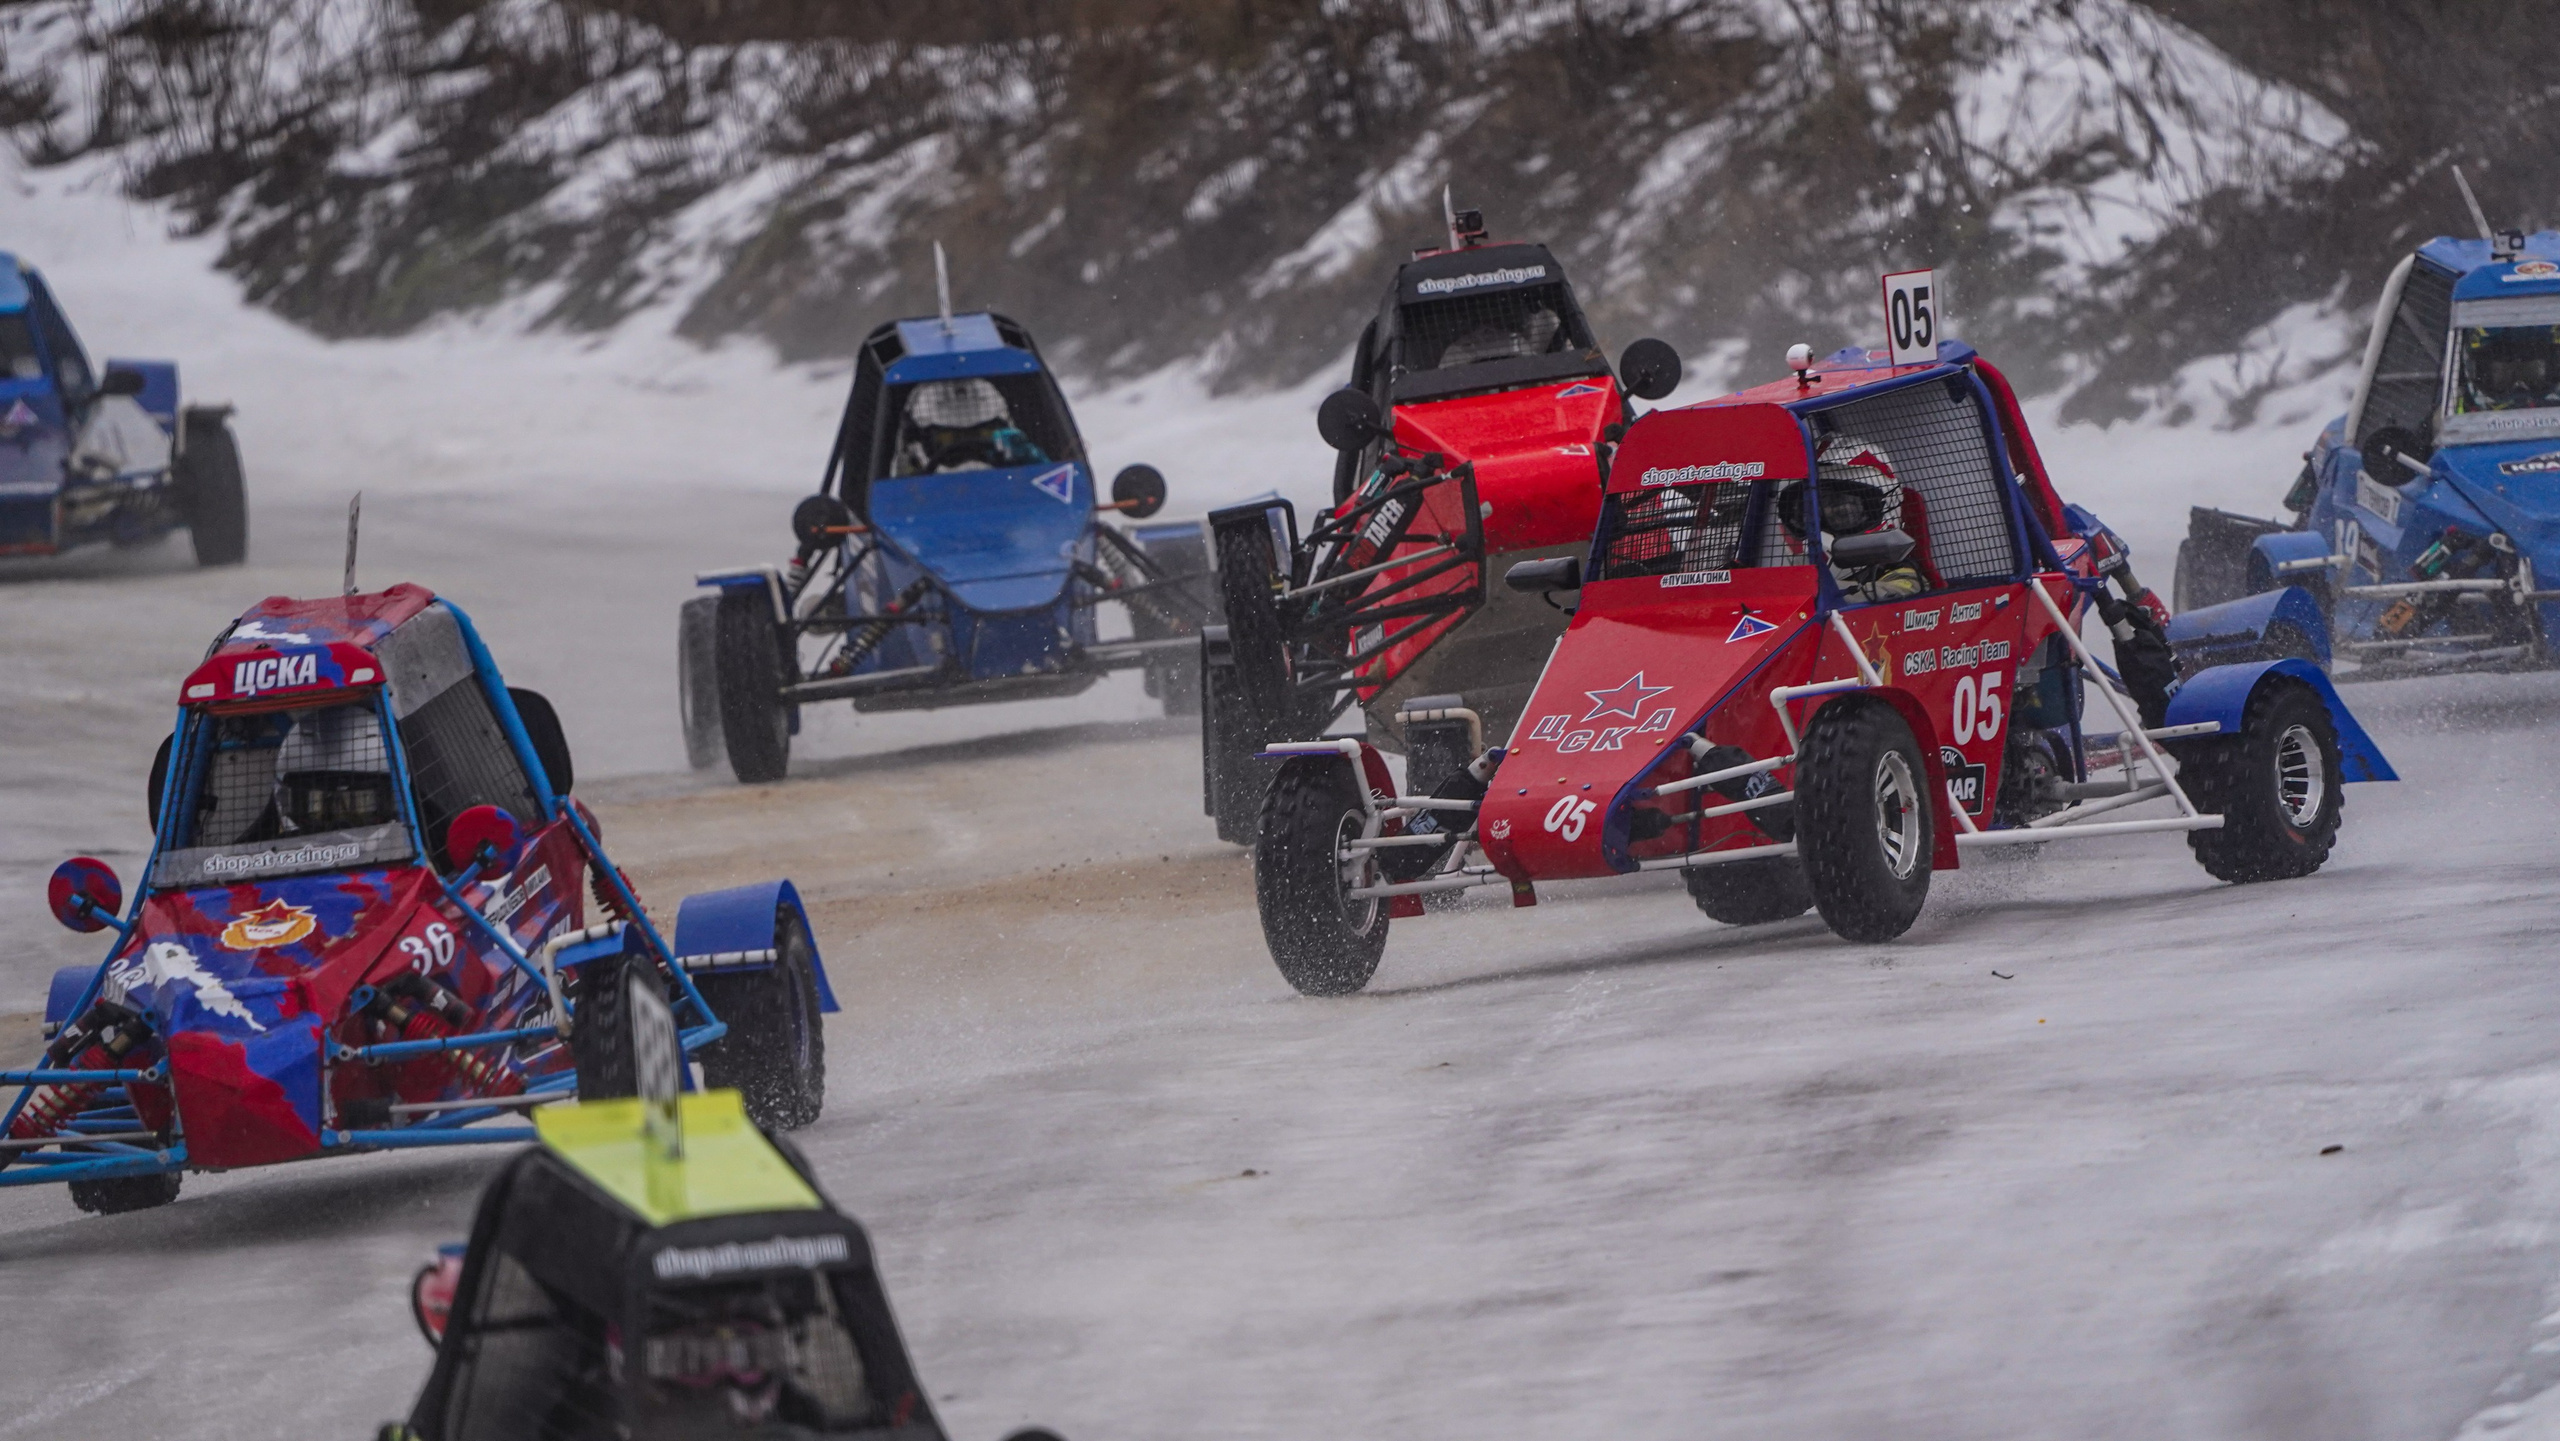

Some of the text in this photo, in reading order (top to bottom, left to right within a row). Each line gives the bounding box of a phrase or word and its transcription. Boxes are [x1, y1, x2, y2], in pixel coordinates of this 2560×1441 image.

[1892, 286, 1932, 350] 05
[1641, 461, 1764, 486] shop.at-racing.ru
[1661, 570, 1731, 588] #ПУШКАГОНКА
[1904, 602, 1981, 632] Шмидт Антон
[234, 653, 318, 697] ЦСКА
[1904, 639, 2010, 676] CSKA Racing Team
[1529, 707, 1676, 753] ЦСКА
[1953, 671, 2003, 746] 05
[1544, 795, 1597, 842] 05
[204, 843, 360, 874] shop.at-racing.ru
[400, 922, 456, 977] 36
